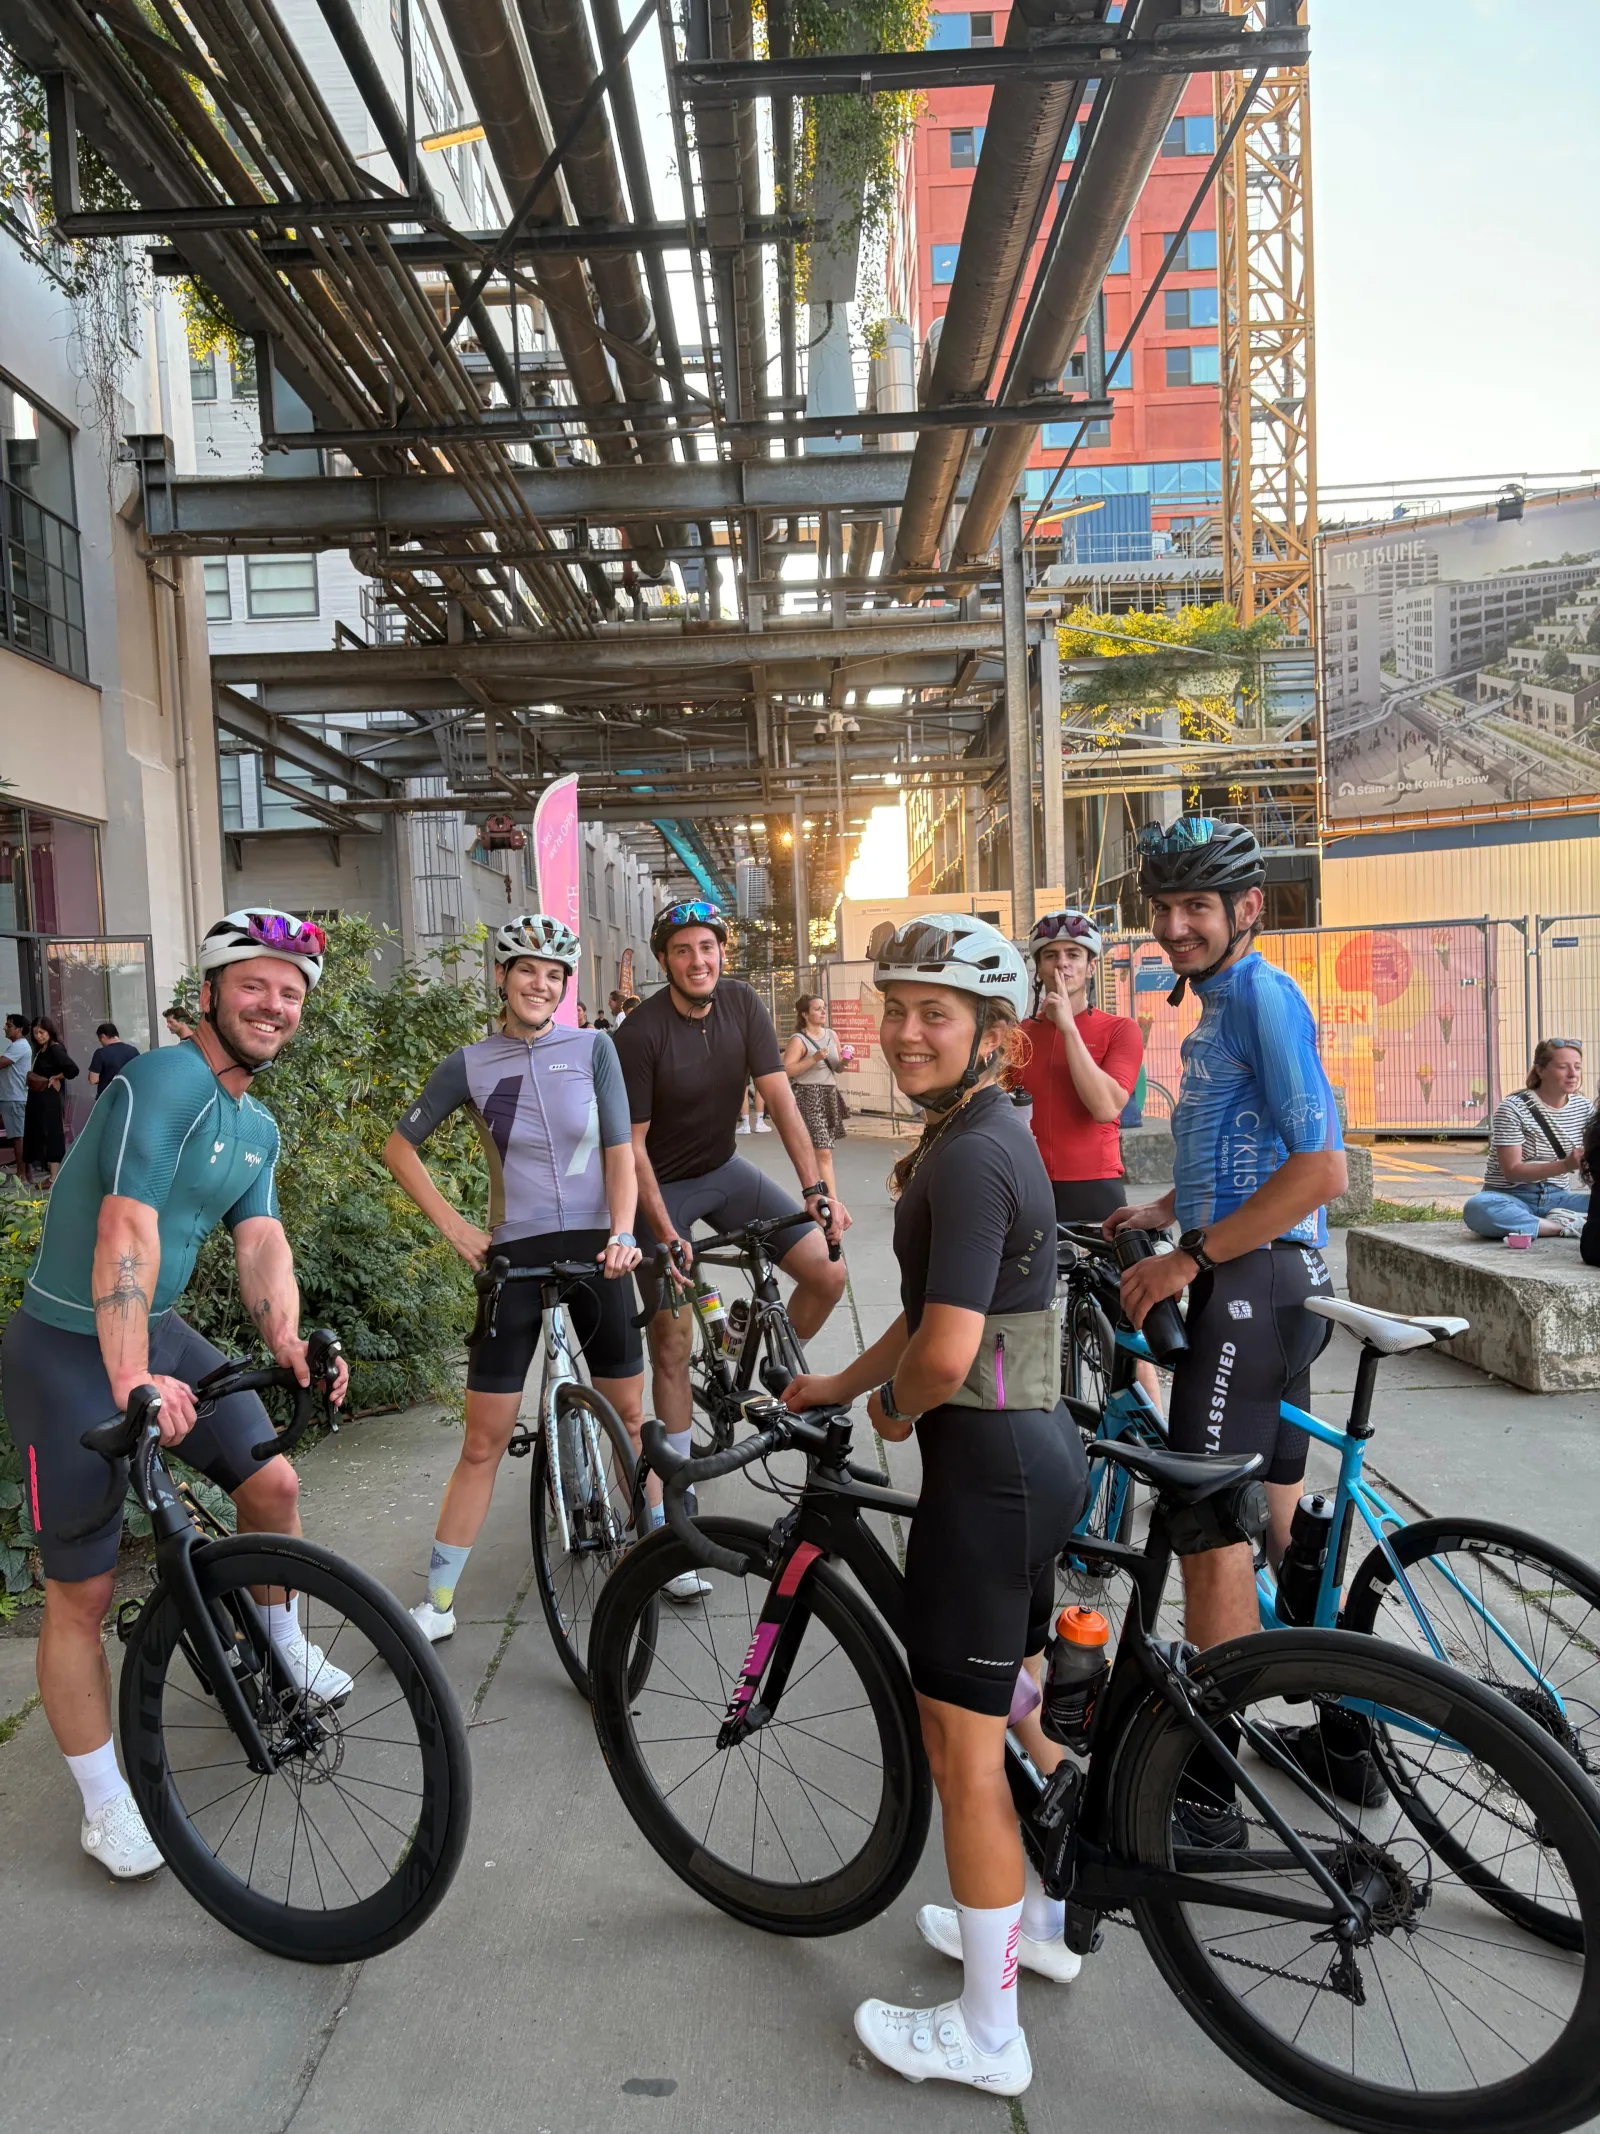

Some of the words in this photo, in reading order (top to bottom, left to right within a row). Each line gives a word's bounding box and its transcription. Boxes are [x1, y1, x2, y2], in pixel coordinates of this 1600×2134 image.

[1332, 539, 1427, 572] TRIBUNE
[1356, 784, 1386, 796] Stam
[1397, 781, 1412, 792] De
[1414, 778, 1454, 789] Koning
[1456, 774, 1490, 786] Bouw
[979, 972, 1018, 984] LIMAR
[1205, 1341, 1237, 1455] LASSIFIED
[1001, 1914, 1021, 1990] MILAN
